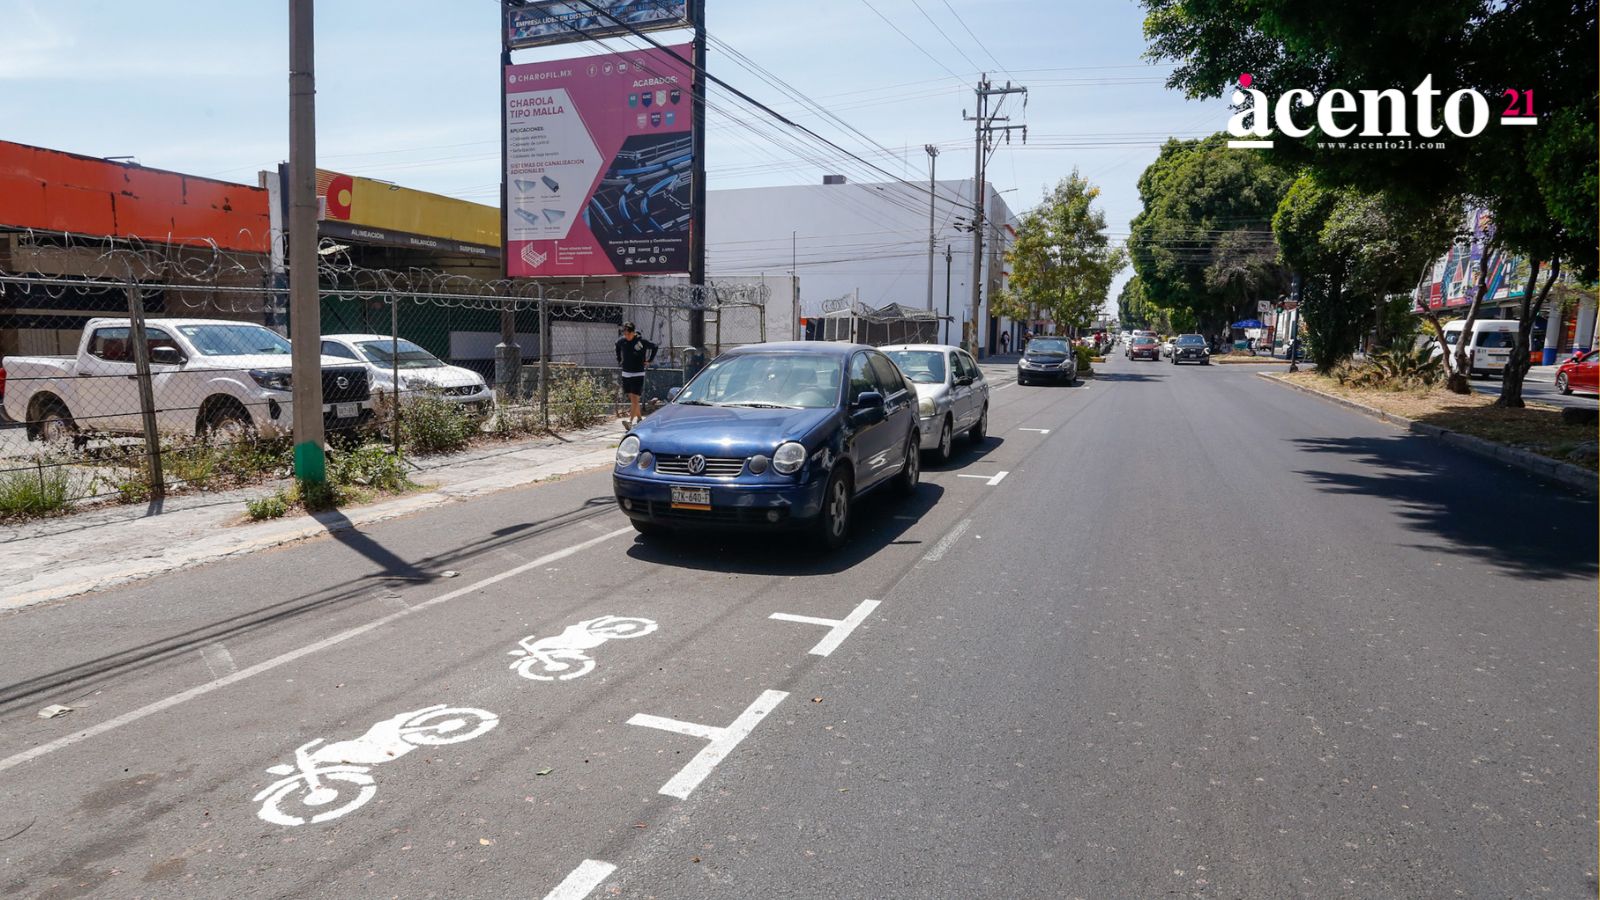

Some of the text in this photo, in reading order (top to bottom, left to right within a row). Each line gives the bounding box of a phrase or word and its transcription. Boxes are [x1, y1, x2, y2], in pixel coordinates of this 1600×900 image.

[516, 18, 541, 27] EMPRESA
[518, 70, 572, 82] CHAROFIL.MX
[633, 76, 678, 88] ACABADOS:
[510, 96, 554, 108] CHAROLA
[510, 106, 564, 119] TIPO MALLA
